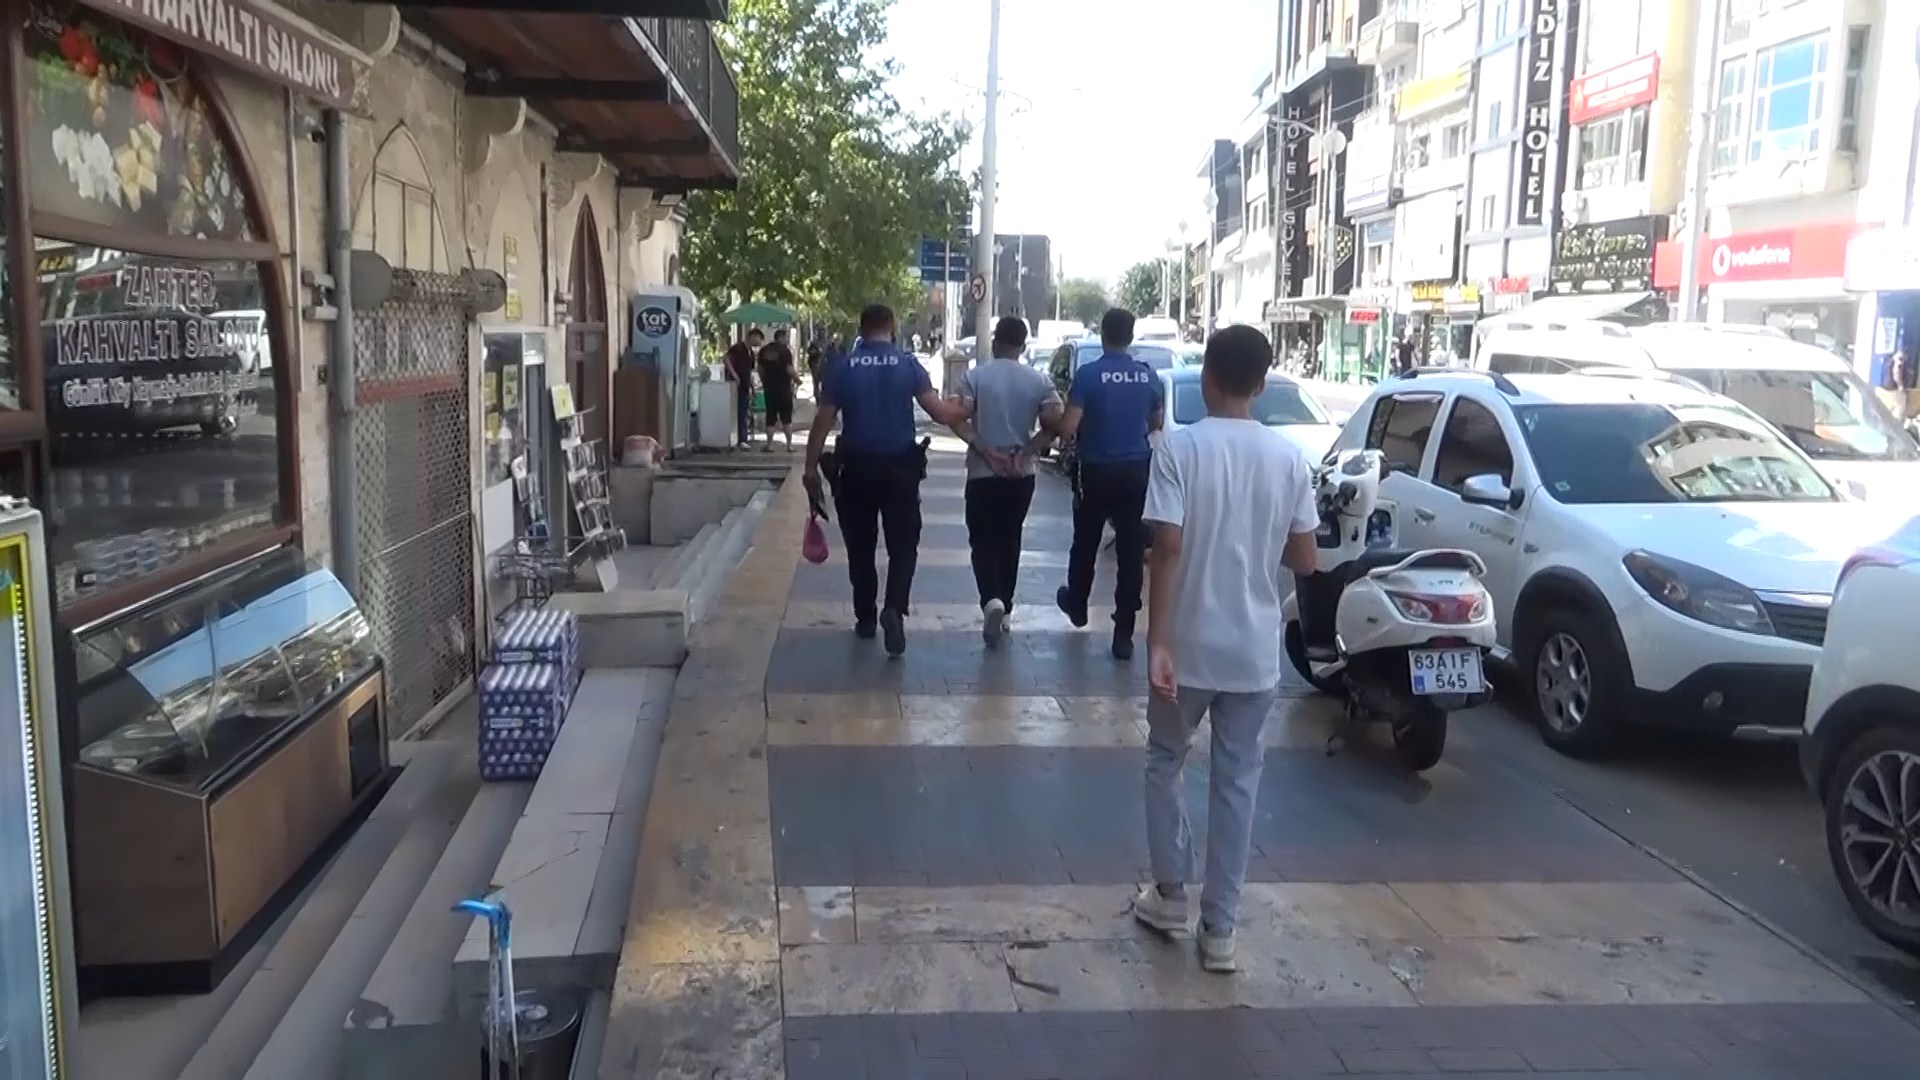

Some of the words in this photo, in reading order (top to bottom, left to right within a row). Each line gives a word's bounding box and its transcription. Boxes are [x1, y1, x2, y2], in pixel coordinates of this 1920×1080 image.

[266, 24, 340, 98] SALONU
[1286, 106, 1300, 191] HOTEL
[1525, 108, 1549, 219] HOTEL
[56, 320, 180, 364] KAHVALTI
[642, 311, 668, 325] tat
[1436, 673, 1467, 689] 545
